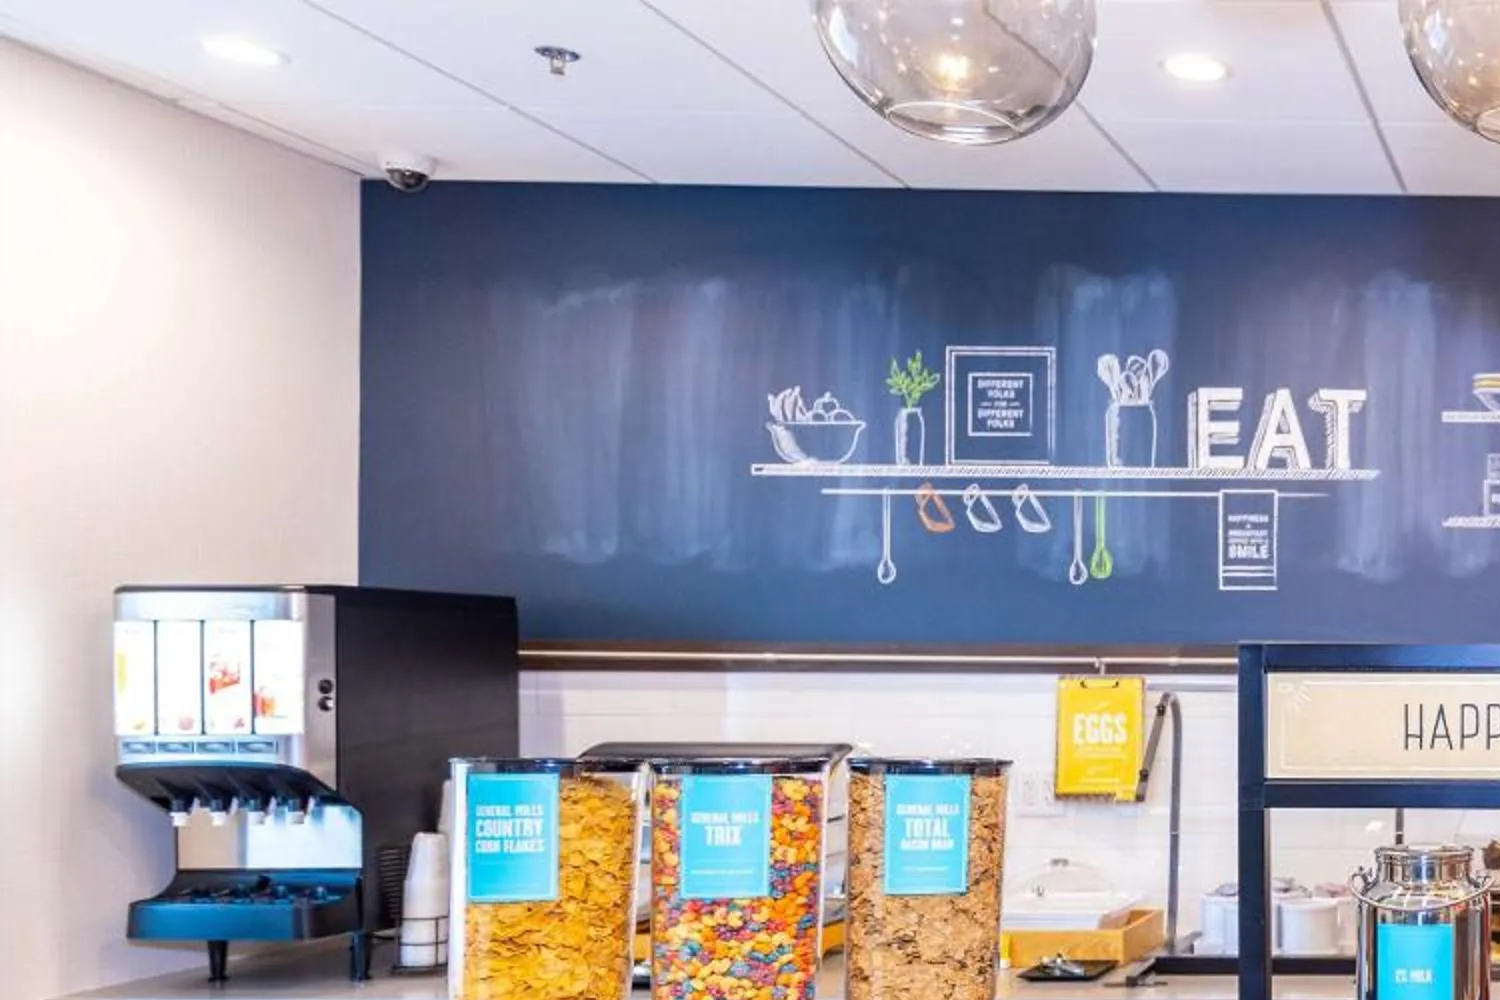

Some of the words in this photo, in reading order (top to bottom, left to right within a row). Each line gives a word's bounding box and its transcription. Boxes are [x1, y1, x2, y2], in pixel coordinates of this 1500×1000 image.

[1188, 387, 1367, 469] EAT
[1228, 545, 1270, 559] SMILE
[1073, 712, 1127, 745] EGGS
[475, 818, 544, 838] COUNTRY
[704, 825, 743, 847] TRIX
[905, 817, 952, 838] TOTAL
[503, 839, 546, 853] FLAKES
